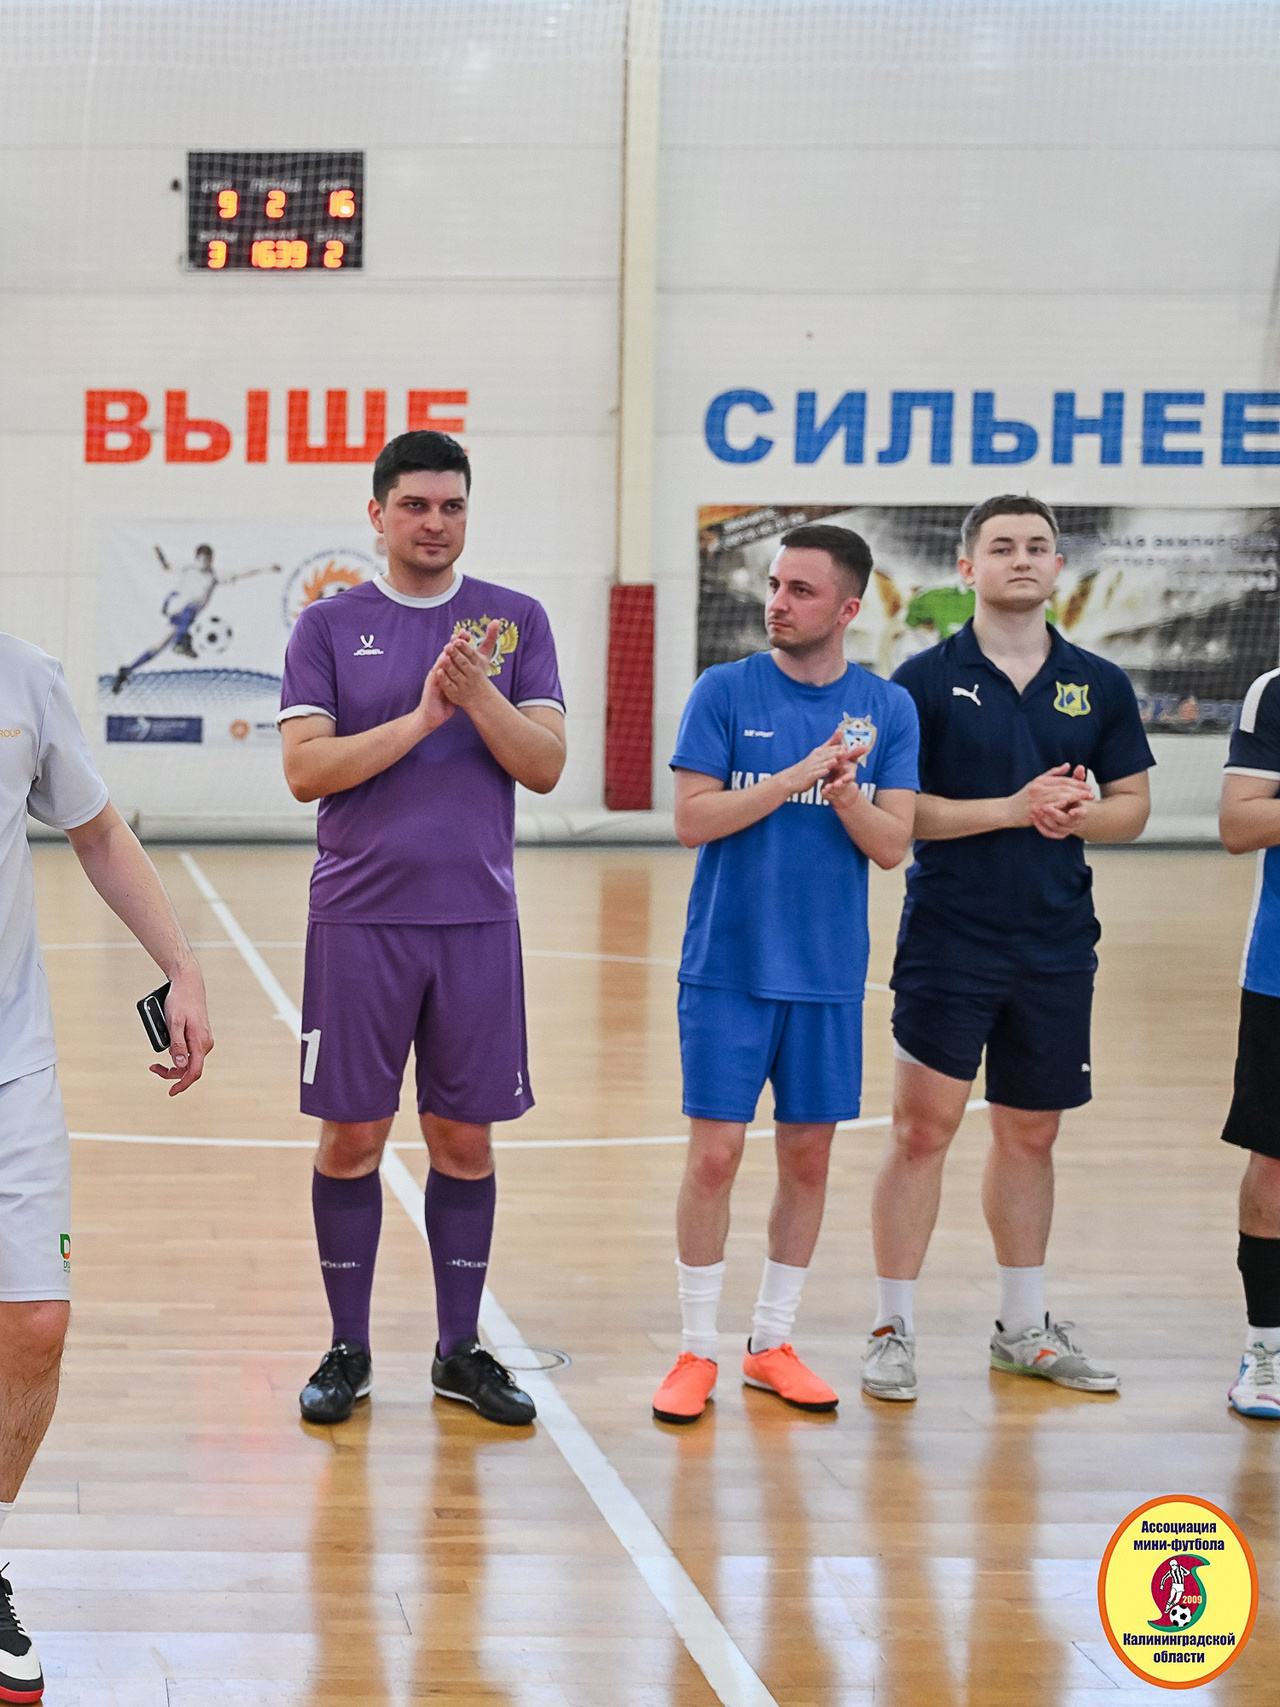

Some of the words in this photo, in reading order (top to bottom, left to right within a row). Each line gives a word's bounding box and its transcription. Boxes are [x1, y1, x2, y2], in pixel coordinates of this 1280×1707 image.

[218, 190, 238, 218] 9
[266, 190, 286, 218] 2
[329, 190, 355, 218] 16
[208, 240, 227, 269] 3
[323, 240, 344, 269] 2
[84, 388, 469, 464] ВЫШЕ
[703, 388, 1280, 466] СИЛЬНЕЕ
[302, 1028, 322, 1085] 1
